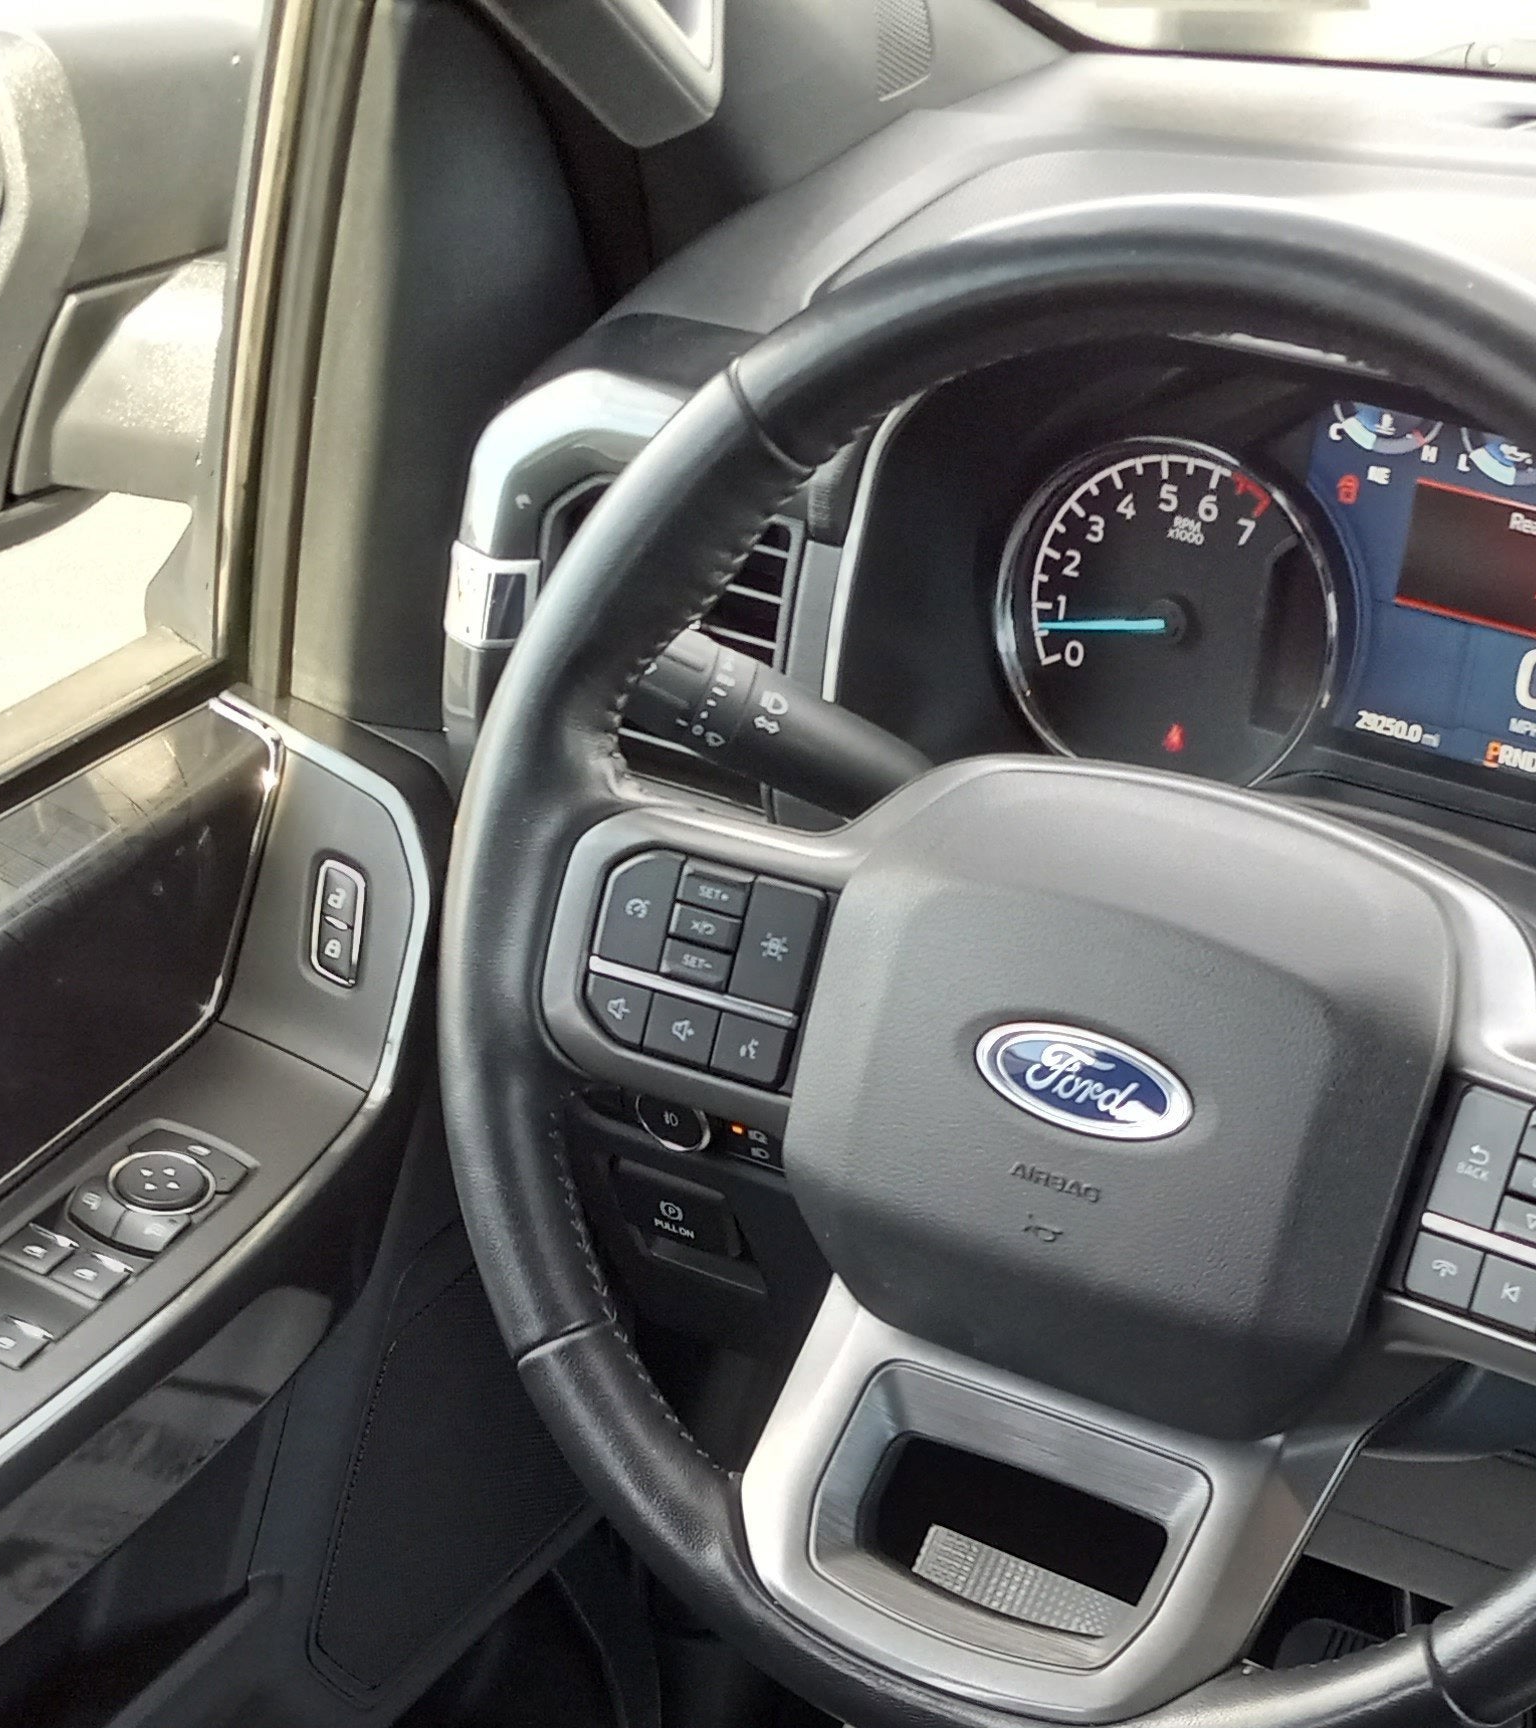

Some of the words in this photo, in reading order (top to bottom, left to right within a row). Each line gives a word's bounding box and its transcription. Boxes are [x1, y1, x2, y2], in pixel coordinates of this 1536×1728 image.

[1116, 493, 1137, 520] 4
[1158, 484, 1179, 512] 5
[1197, 495, 1219, 522] 6
[1085, 515, 1106, 543] 3
[1173, 515, 1202, 534] RPM
[1236, 518, 1257, 546] 7
[1062, 550, 1082, 577] 2
[1056, 595, 1067, 620] 1
[1064, 640, 1085, 668] 0
[1025, 1043, 1140, 1119] Ford
[1011, 1162, 1101, 1204] AIRBAG
[1456, 1161, 1490, 1182] BACK
[654, 1217, 679, 1234] PULL
[678, 1226, 696, 1240] ON
